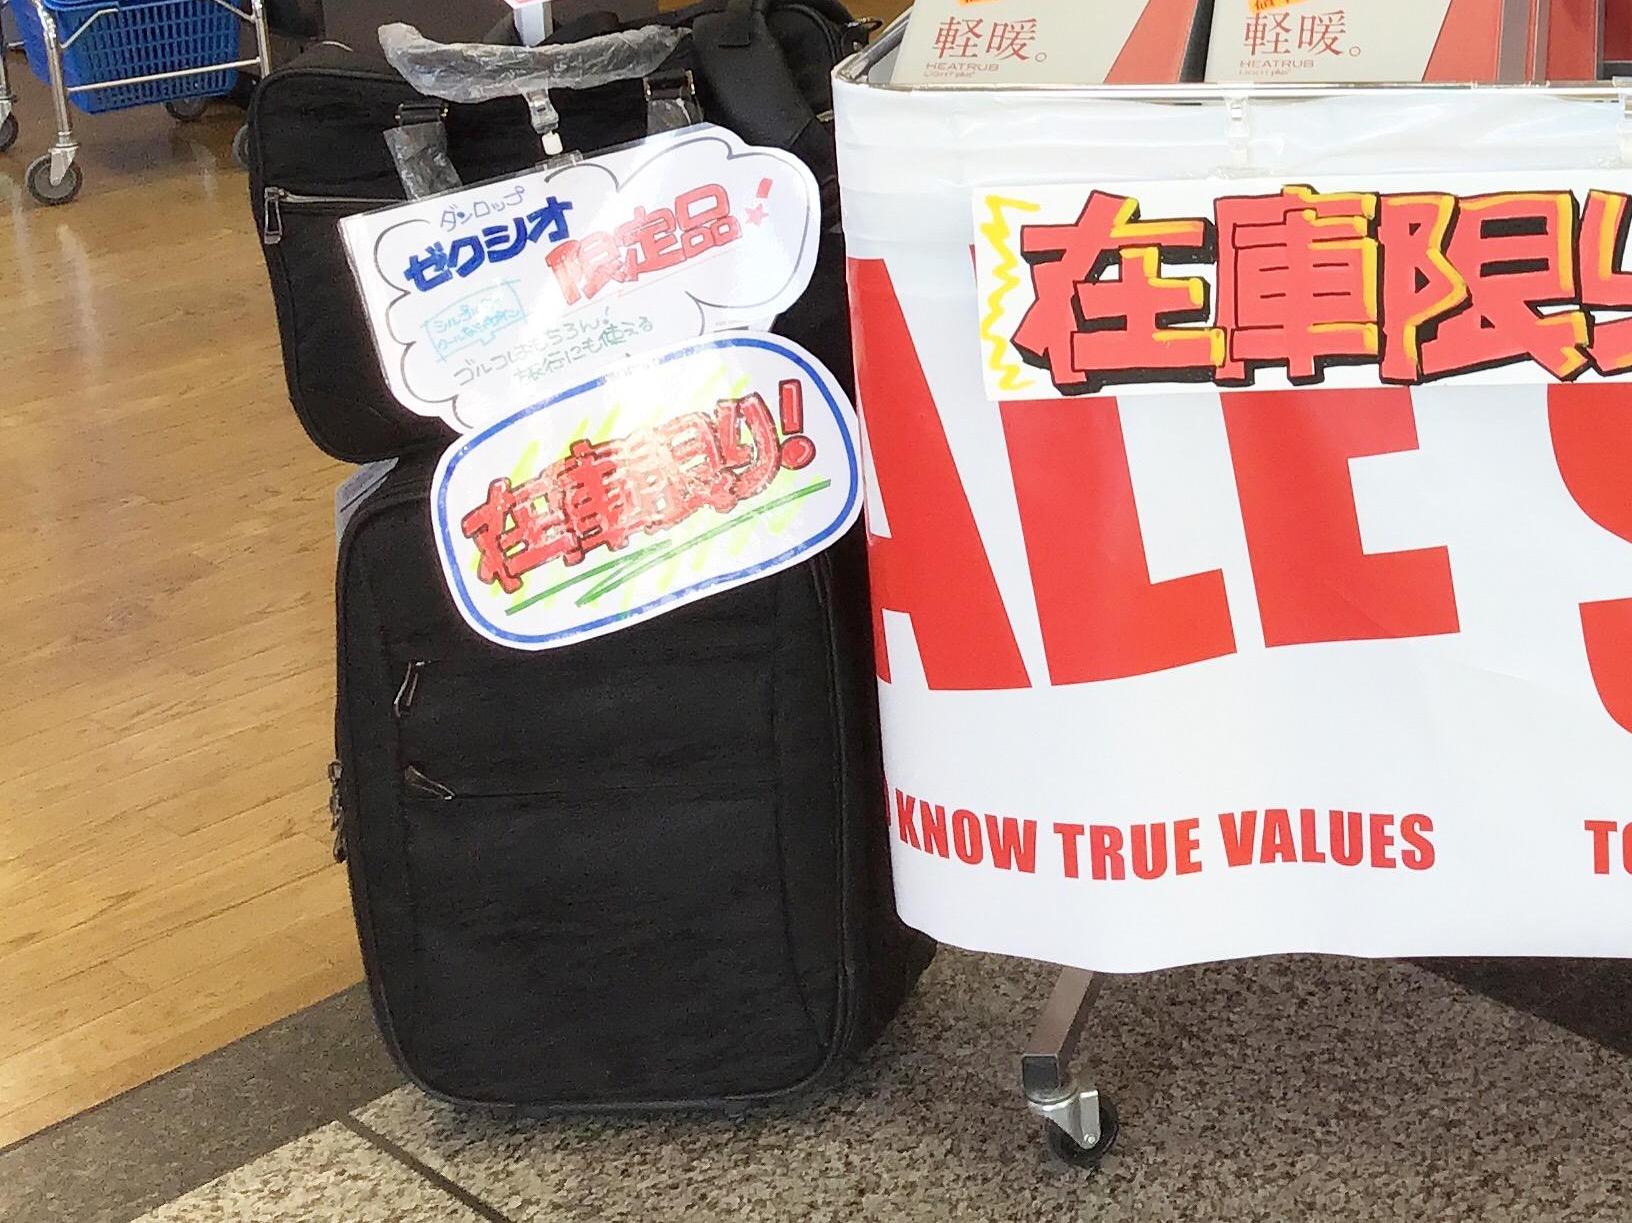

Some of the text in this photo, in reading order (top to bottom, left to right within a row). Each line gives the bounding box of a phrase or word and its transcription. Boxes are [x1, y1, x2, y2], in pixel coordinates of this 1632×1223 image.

[932, 16, 1048, 63] 軽暖。
[1243, 9, 1362, 58] 軽暖。
[925, 62, 1000, 71] HEATRUB
[1238, 59, 1315, 68] HEATRUB
[439, 186, 526, 233] ダンロップ
[403, 195, 574, 292] ゼクシオ
[462, 378, 816, 595] 在庫限り!
[895, 788, 1037, 874] KNOW
[1053, 817, 1202, 880] TRUE
[1218, 808, 1435, 871] VALUES
